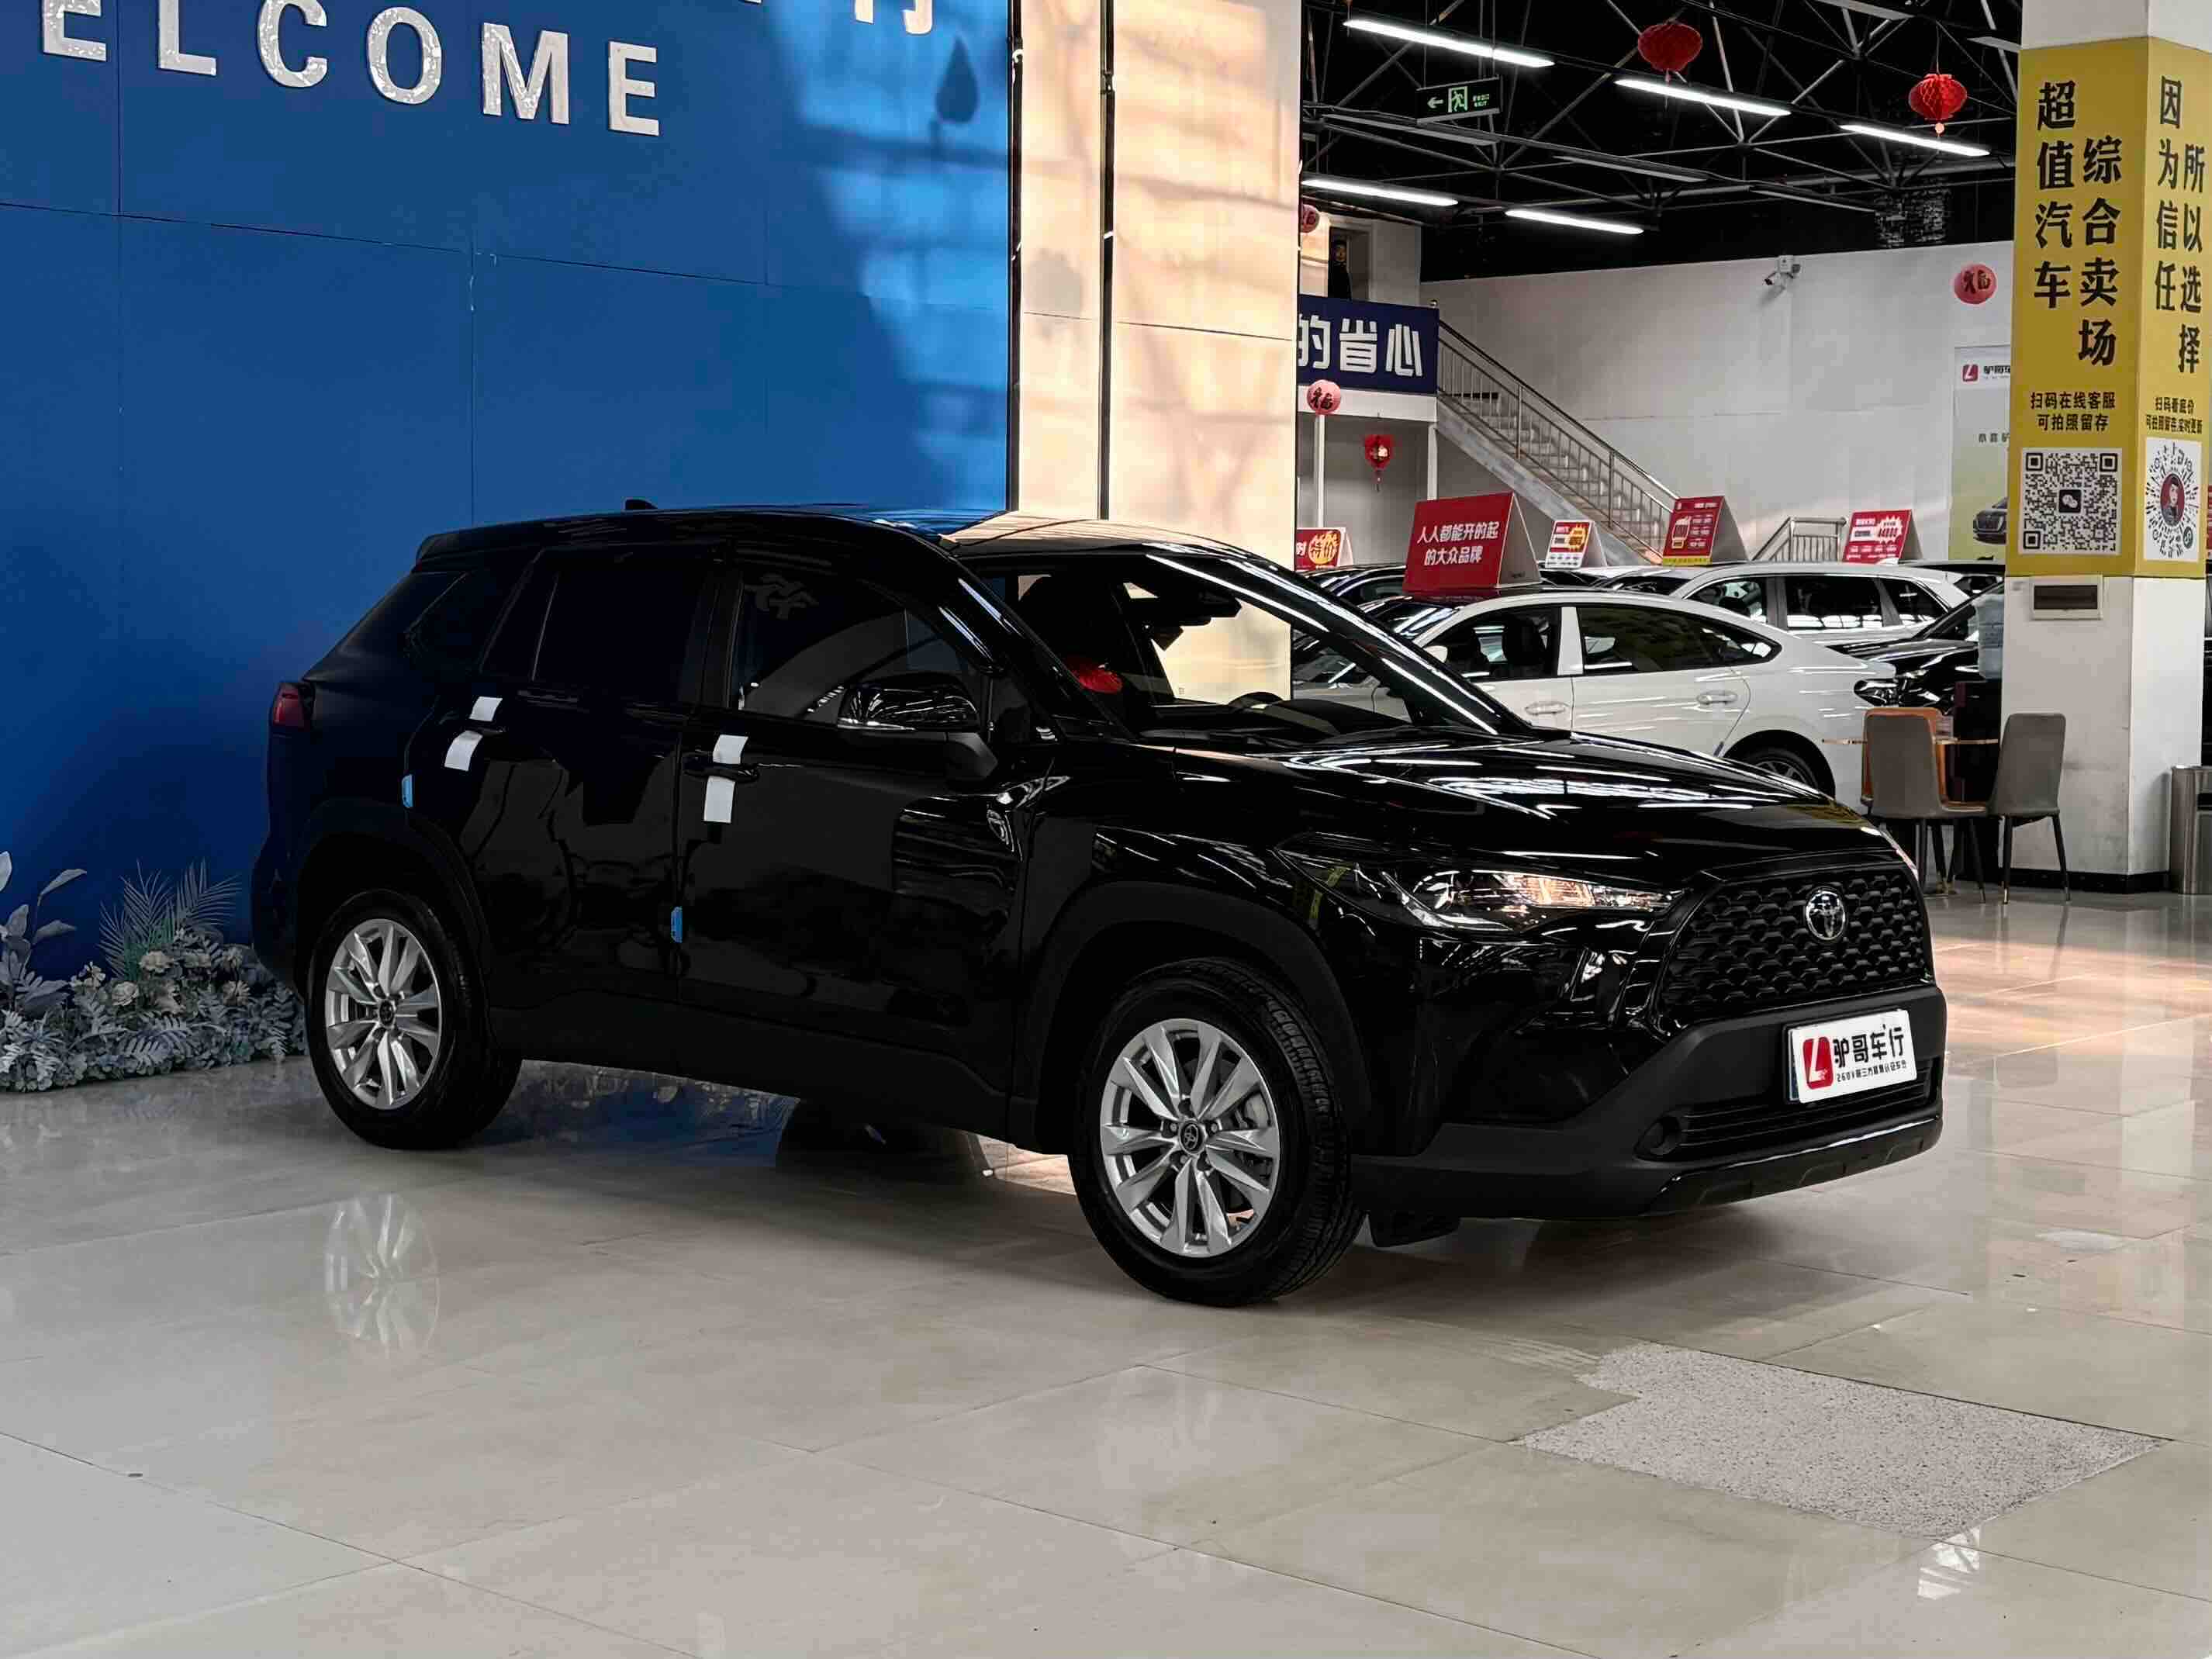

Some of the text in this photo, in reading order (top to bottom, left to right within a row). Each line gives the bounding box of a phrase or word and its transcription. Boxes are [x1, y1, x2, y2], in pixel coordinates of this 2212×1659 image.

[2034, 80, 2075, 309] 超值汽车
[2155, 75, 2183, 312] 因为信任
[2079, 135, 2123, 366] 综合卖场
[2179, 143, 2206, 374] 所以选择
[1298, 313, 1422, 377] 的省心
[2031, 391, 2116, 410] 扫码在线客服
[2037, 413, 2110, 432] 可拍照留存
[1417, 521, 1499, 544] 人人都能开的起
[1424, 546, 1483, 566] 的大众品牌
[1833, 1025, 1904, 1067] 驴哥车行
